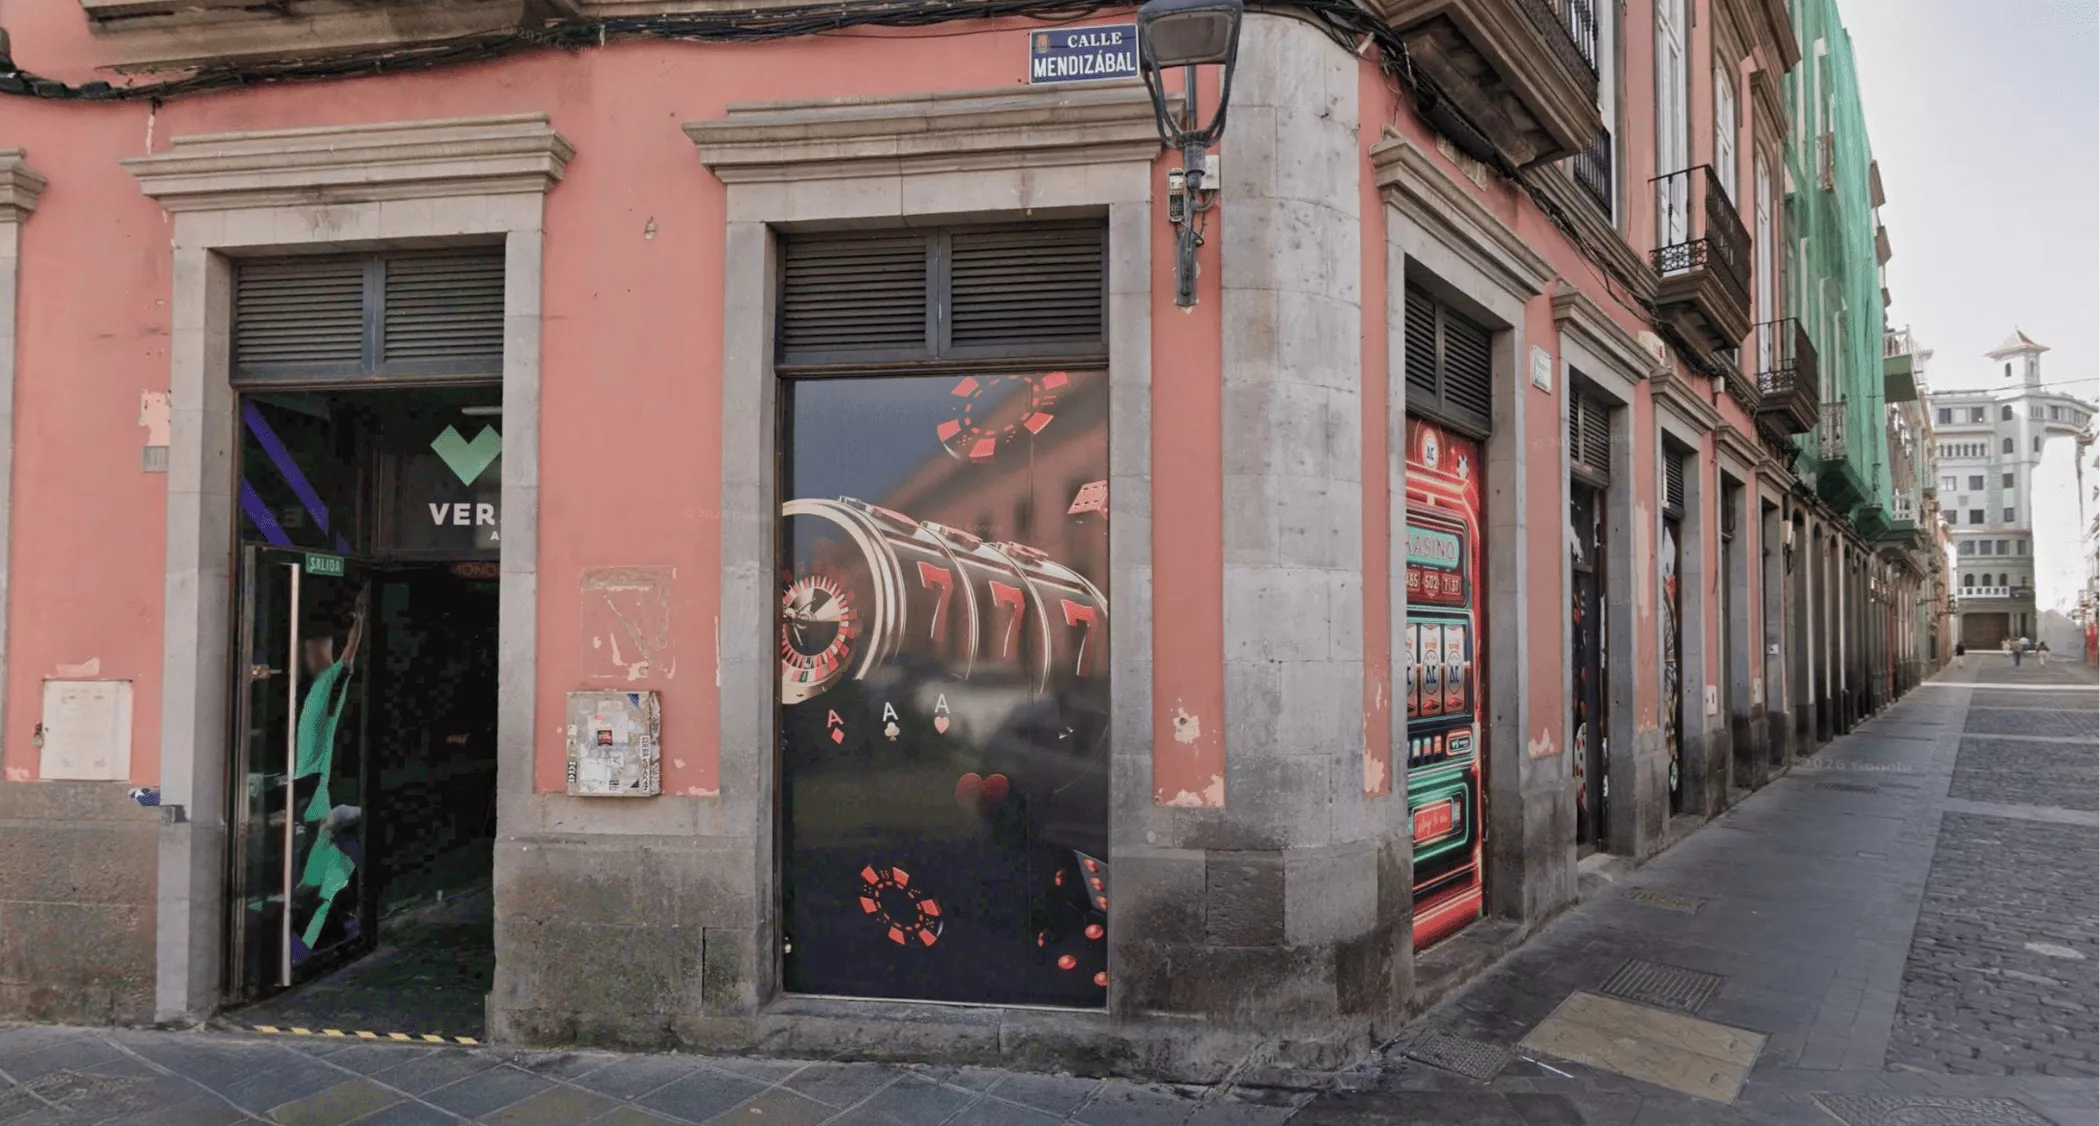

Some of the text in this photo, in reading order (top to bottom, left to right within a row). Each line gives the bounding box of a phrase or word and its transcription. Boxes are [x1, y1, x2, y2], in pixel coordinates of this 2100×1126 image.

[1067, 32, 1122, 48] CALLE
[1034, 49, 1135, 78] MENDIZÁBAL
[428, 502, 502, 526] VER
[310, 556, 341, 572] SALIDA
[917, 561, 1096, 678] 7 7 7
[882, 701, 899, 722] A
[934, 693, 950, 714] A
[826, 708, 844, 728] A
